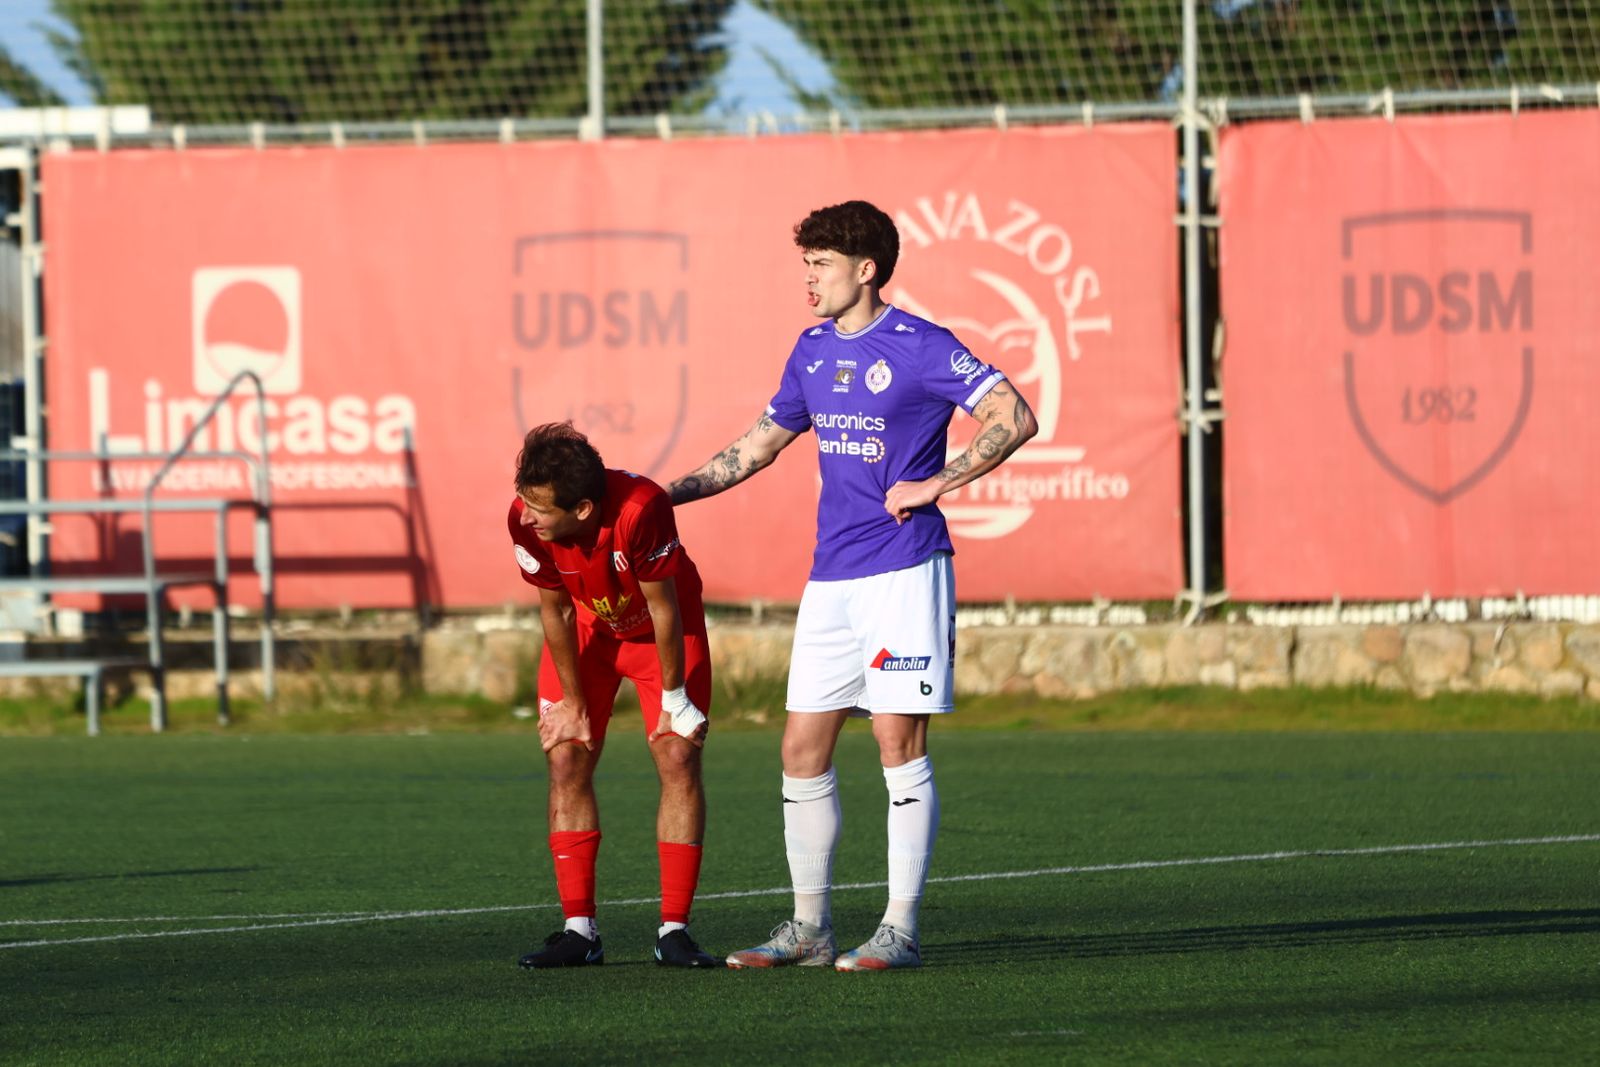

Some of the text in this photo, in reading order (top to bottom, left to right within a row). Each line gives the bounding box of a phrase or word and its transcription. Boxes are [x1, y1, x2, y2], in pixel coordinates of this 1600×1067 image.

[511, 289, 689, 349] UDSM
[1342, 270, 1534, 335] UDSM
[89, 368, 415, 455] Limcasa
[816, 411, 886, 432] euronics
[1400, 385, 1477, 424] 1982
[883, 657, 926, 671] antolin
[919, 680, 933, 696] b
